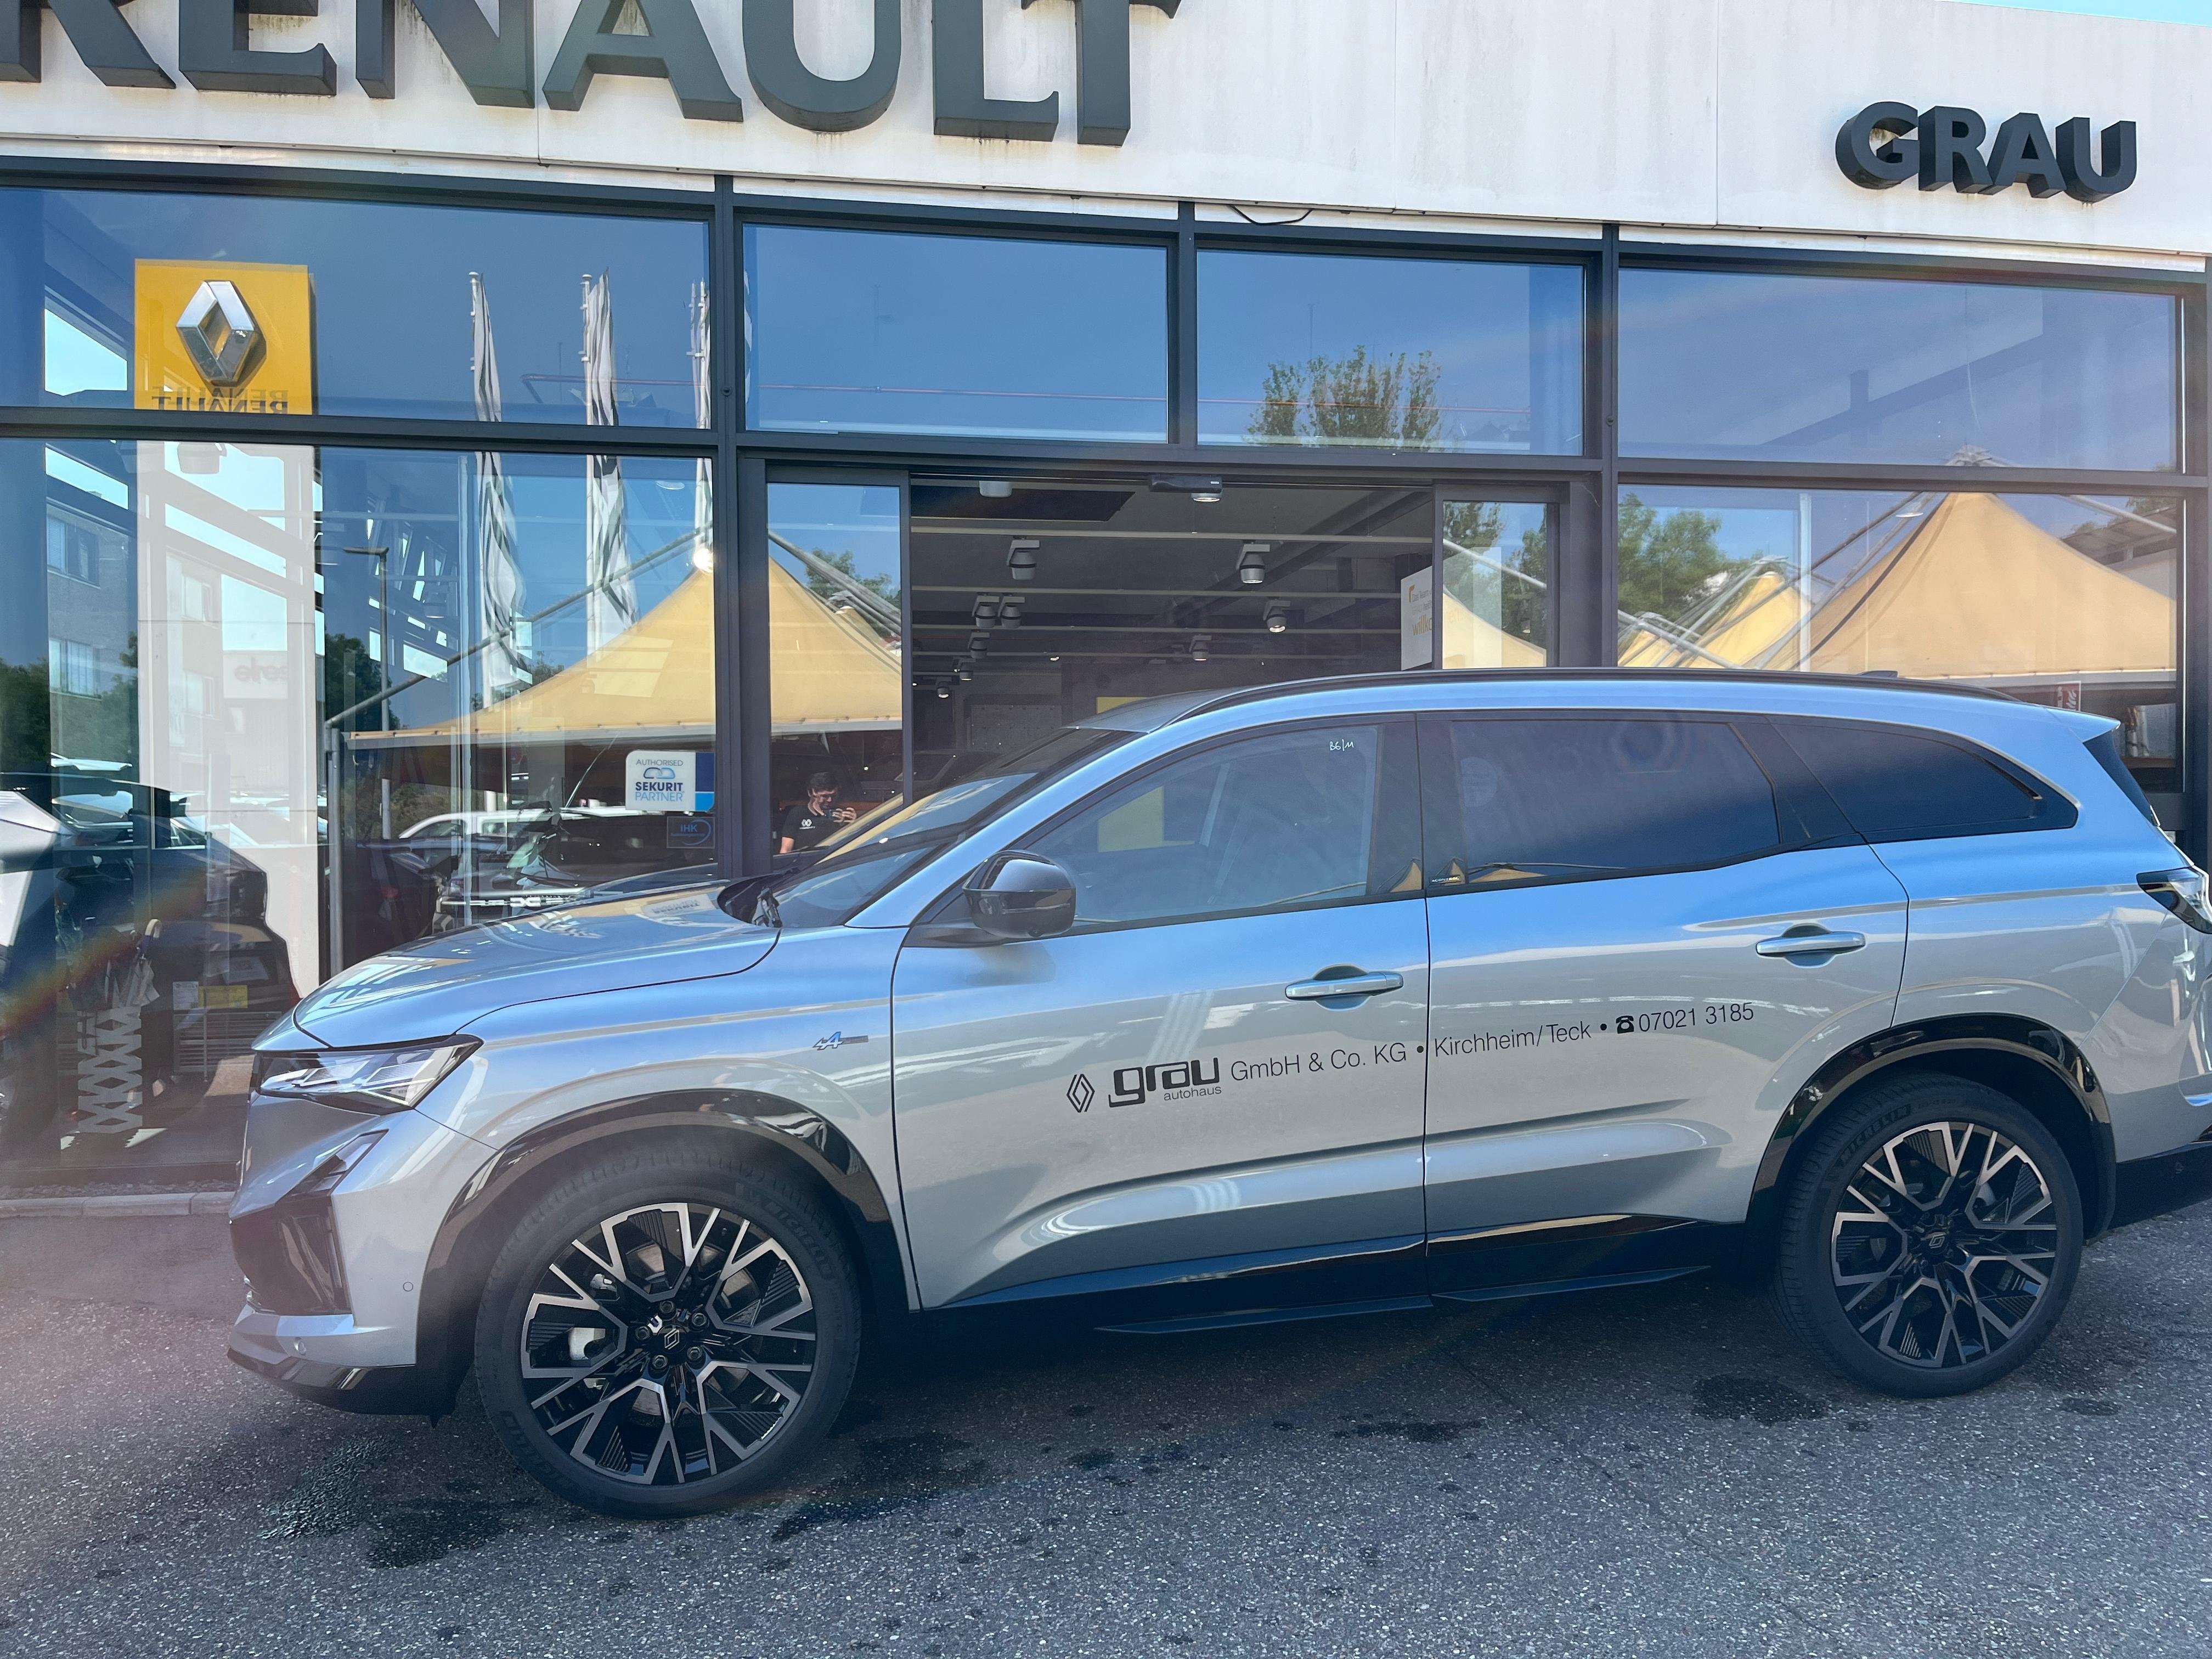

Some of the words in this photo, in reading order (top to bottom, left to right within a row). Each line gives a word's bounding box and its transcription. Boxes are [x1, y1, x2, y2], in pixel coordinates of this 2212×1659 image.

[1836, 101, 2137, 203] GRAU
[635, 782, 684, 792] SEKURIT
[635, 791, 683, 802] PARTNER
[680, 824, 698, 832] IHK
[1108, 1057, 1220, 1108] grau
[1231, 1054, 1300, 1081] GmbH
[1308, 1052, 1324, 1072] &
[1331, 1049, 1366, 1069] Co.
[1374, 1042, 1407, 1064] KG
[1435, 1020, 1592, 1057] Kirchheim/Teck
[1639, 1008, 1696, 1032] 07021
[1705, 1002, 1754, 1024] 3185
[1164, 1086, 1222, 1101] autohaus
